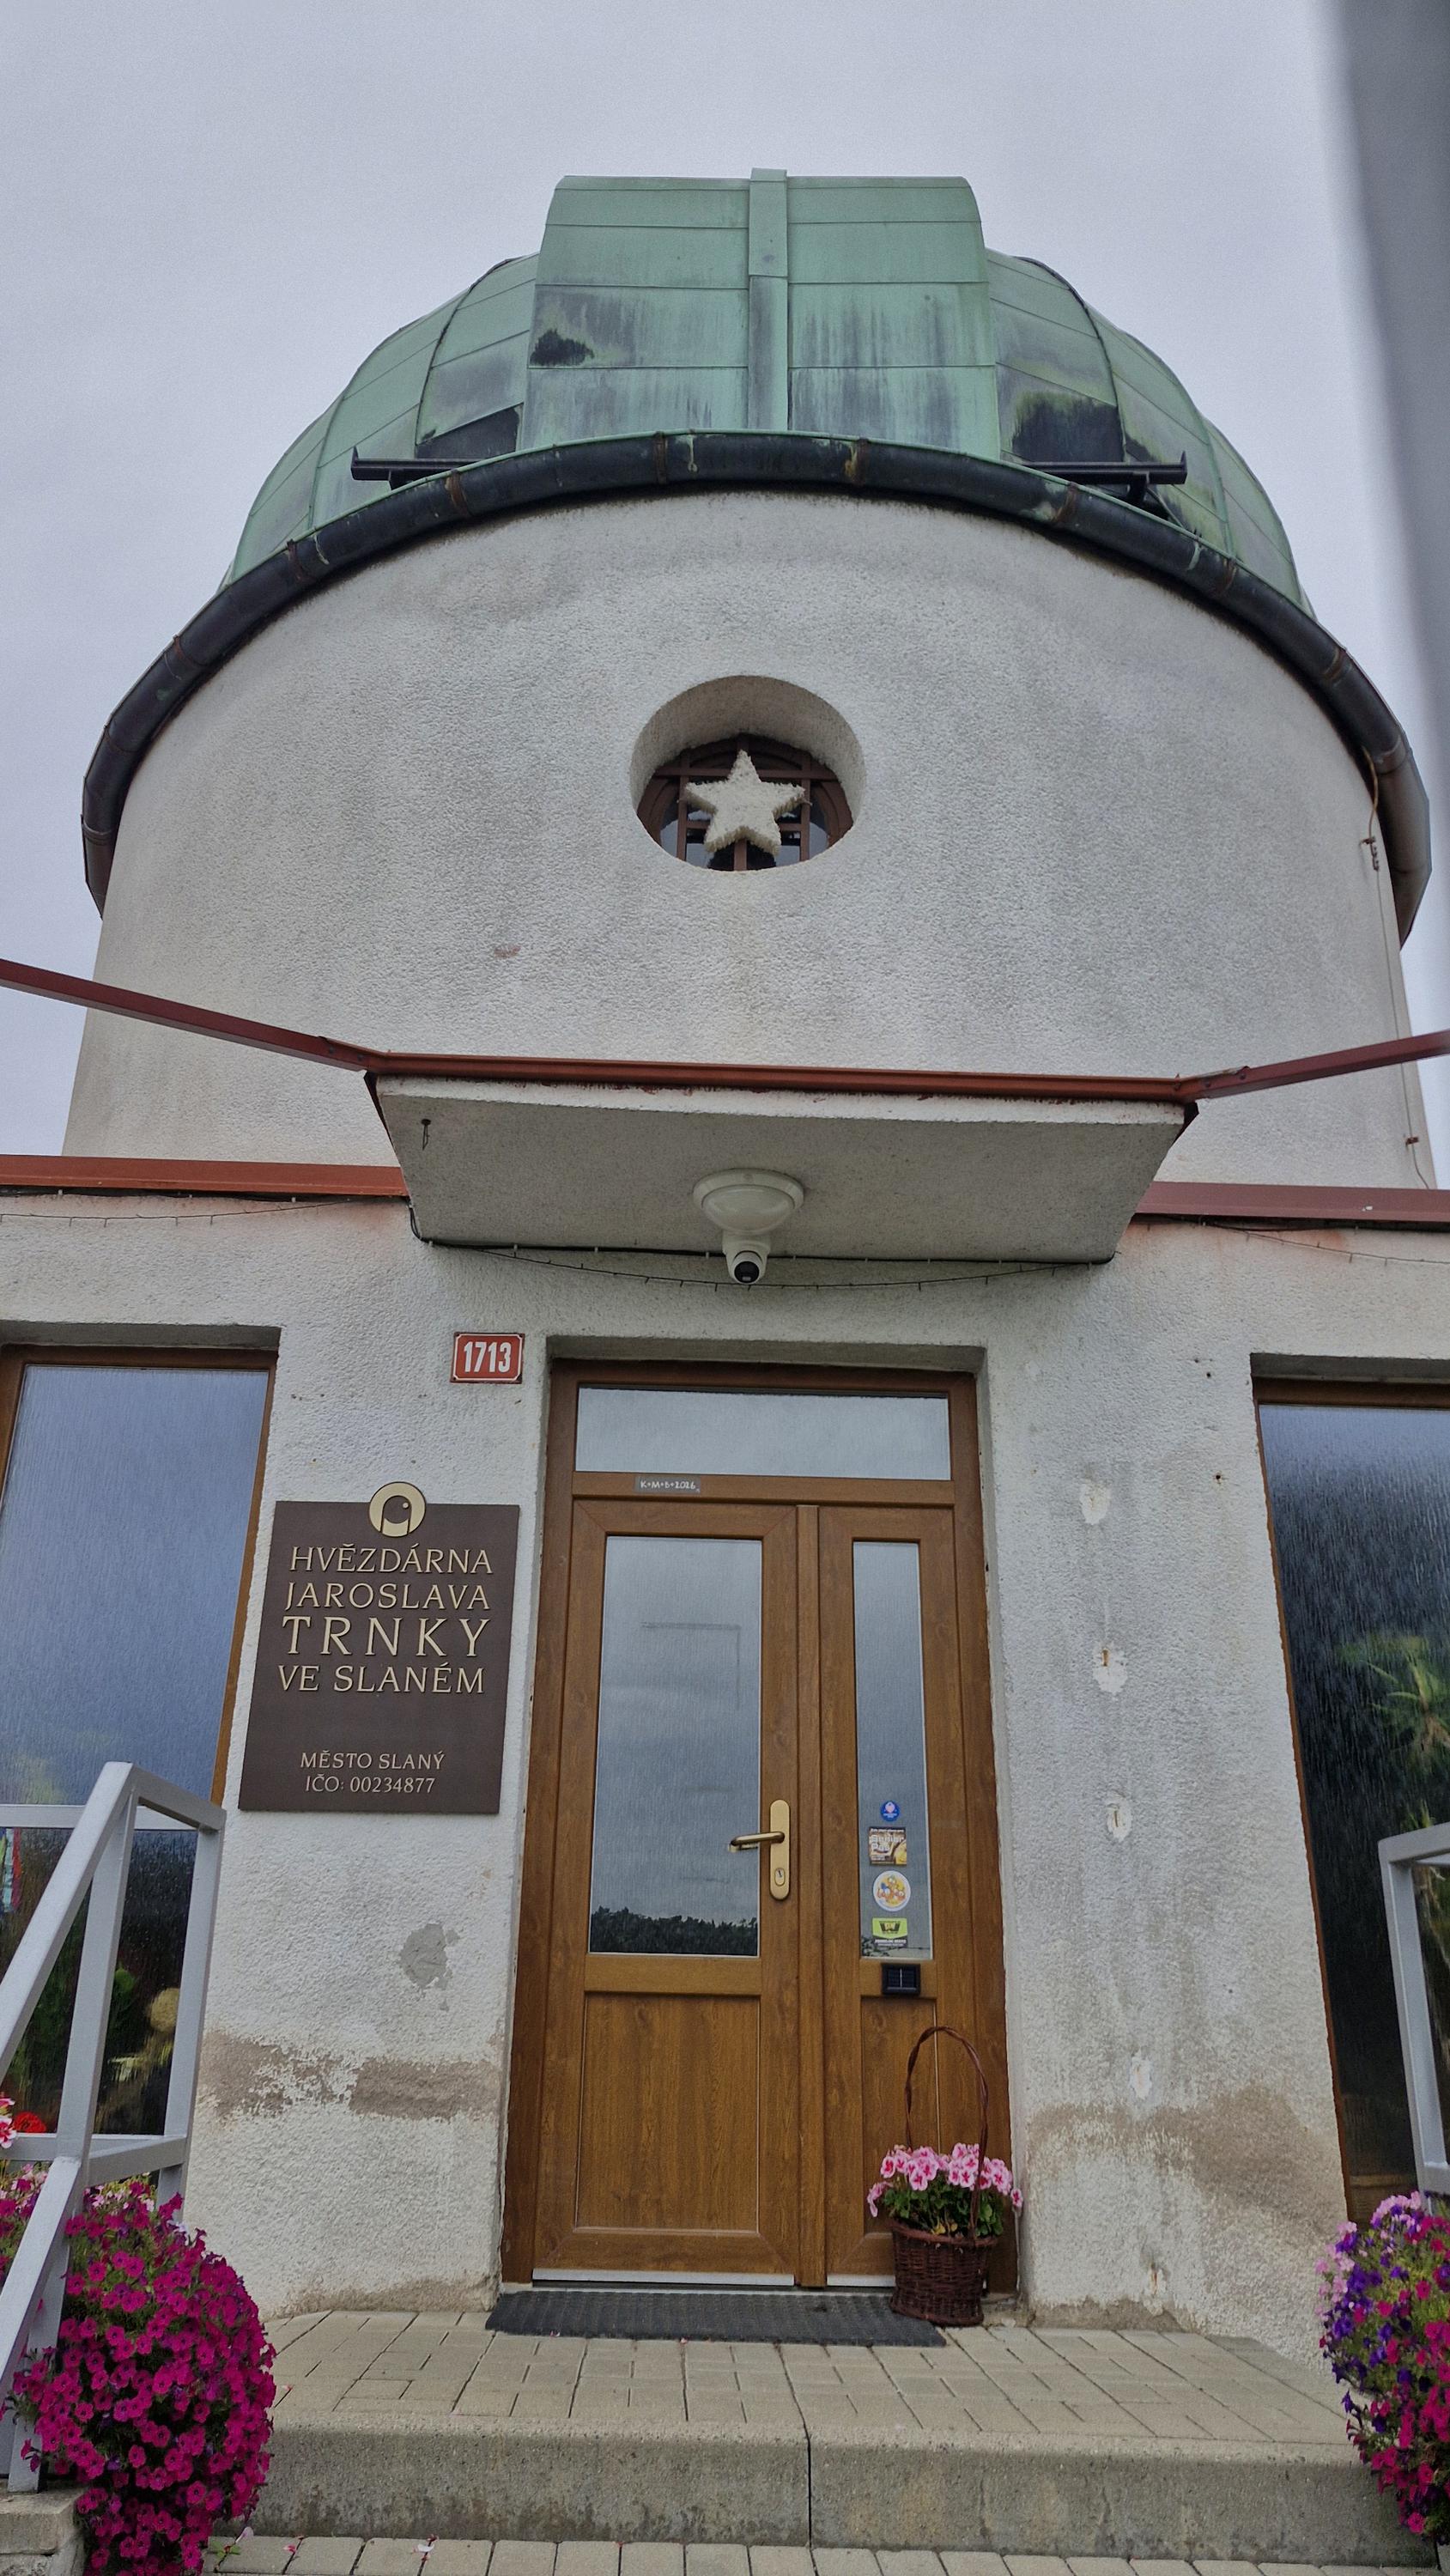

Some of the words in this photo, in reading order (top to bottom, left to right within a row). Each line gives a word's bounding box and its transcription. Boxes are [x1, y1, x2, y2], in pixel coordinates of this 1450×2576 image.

[464, 1341, 513, 1373] 1713
[289, 1543, 494, 1575] HVĚZDÁRNA
[284, 1582, 491, 1611] JAROSLAVA
[282, 1615, 491, 1657] TRNKY
[278, 1665, 320, 1692] VE
[333, 1662, 485, 1694] SLANÉM
[300, 1750, 373, 1770] MĚSTO
[378, 1750, 446, 1771] SLANÝ
[305, 1774, 345, 1794] IČO:
[349, 1777, 436, 1795] 00234877
